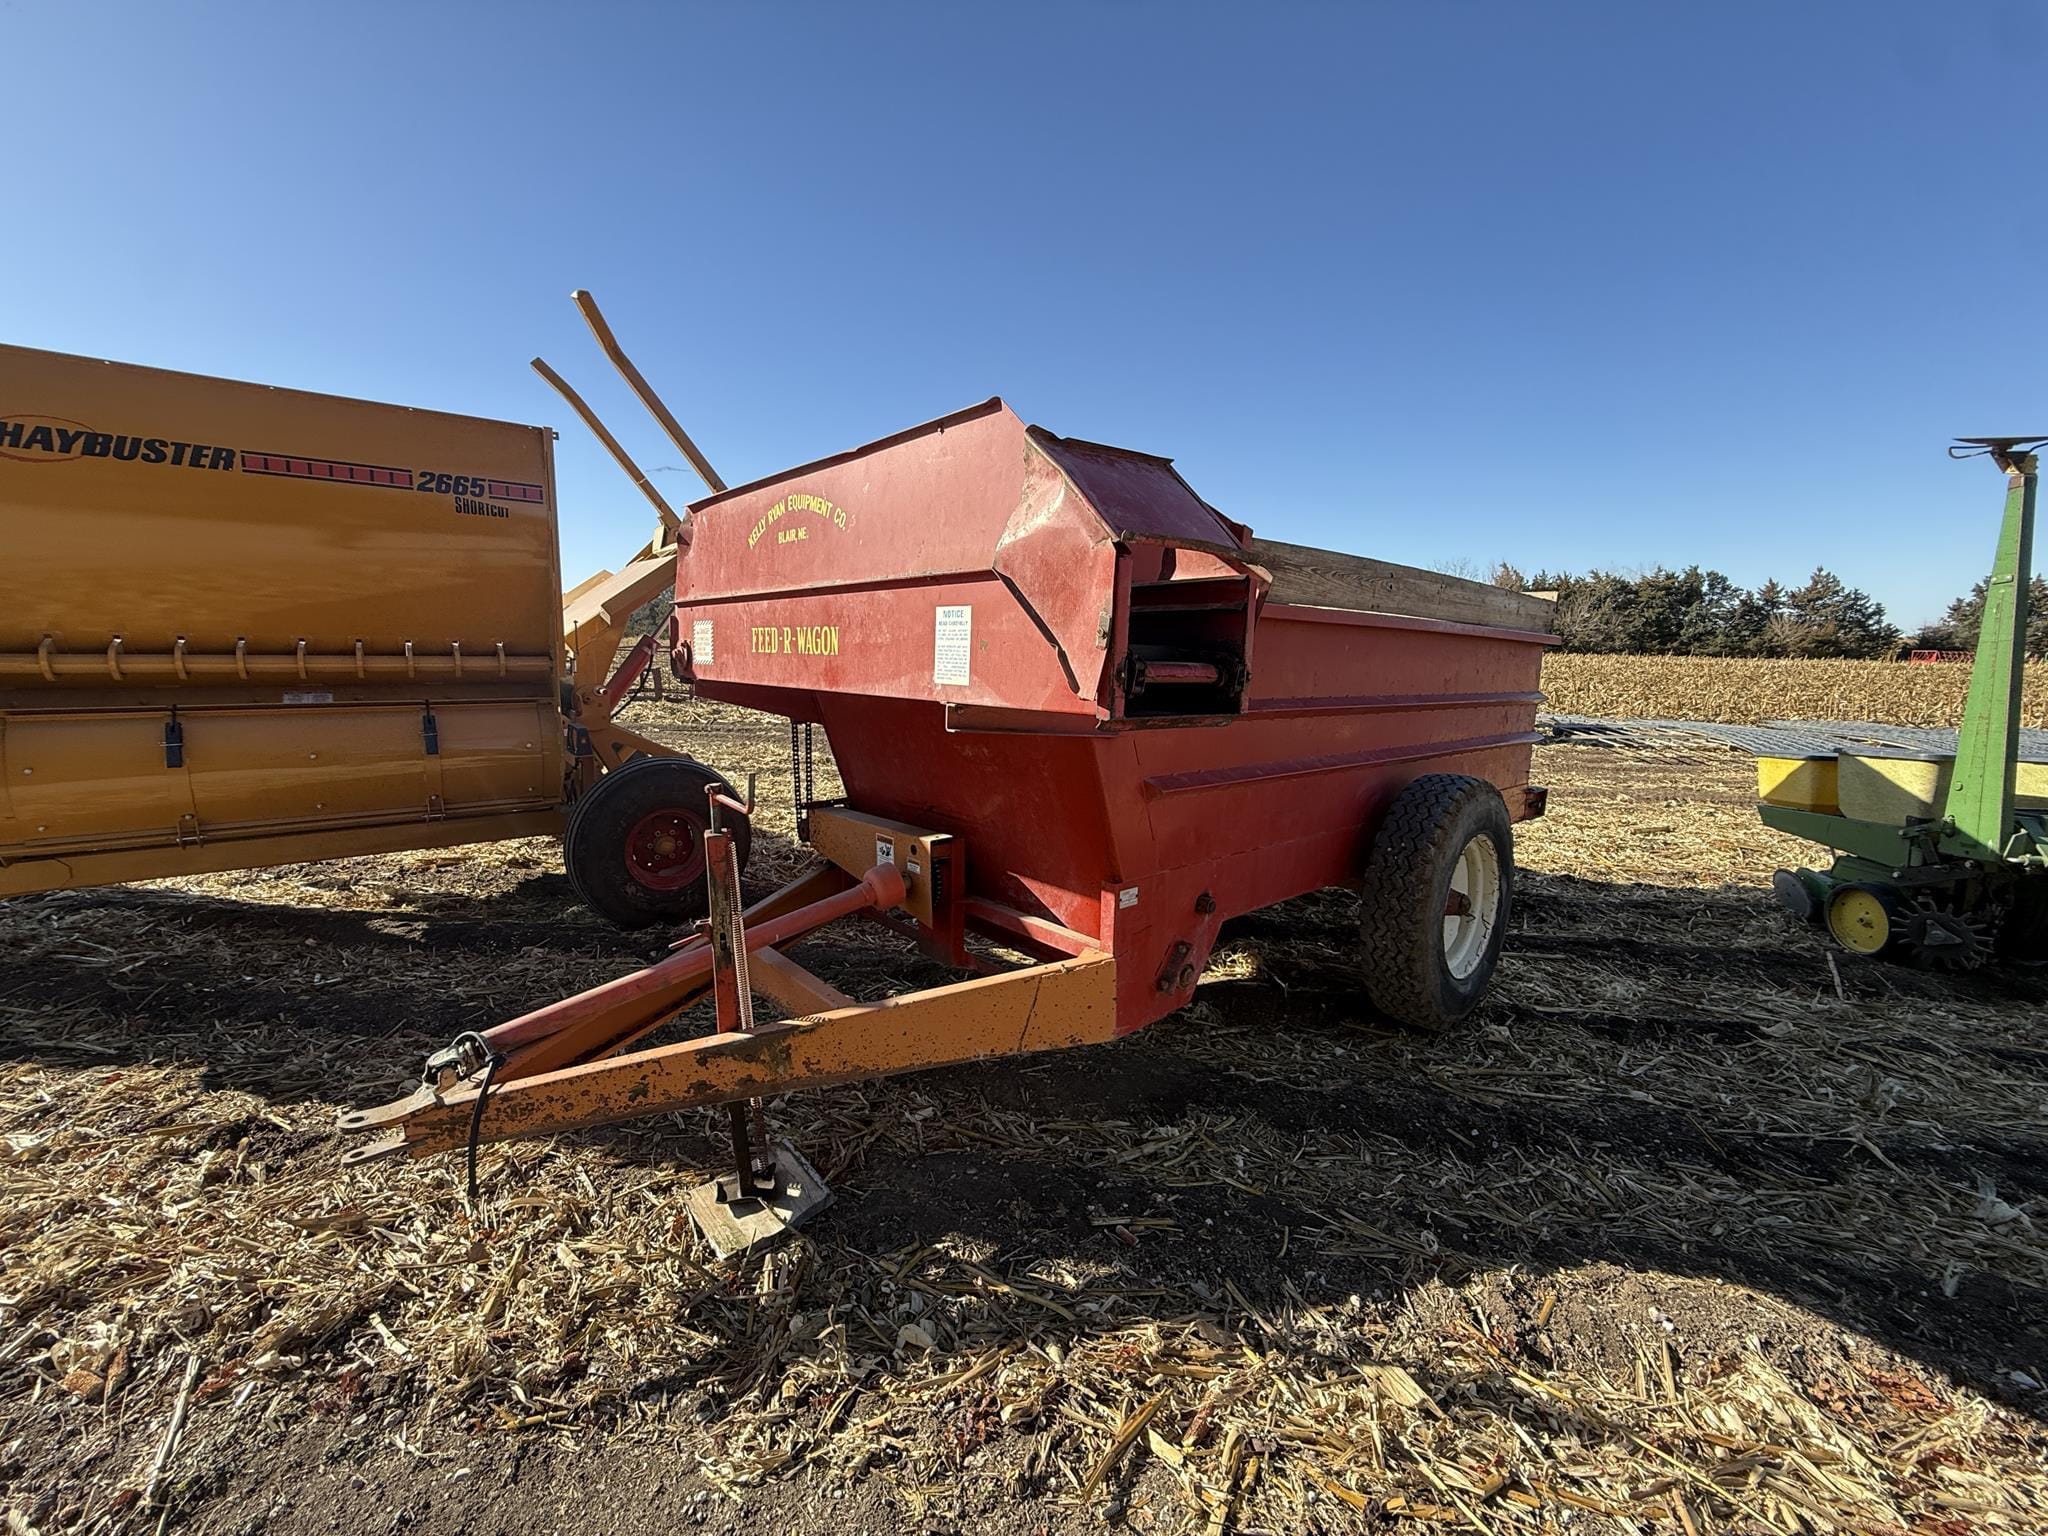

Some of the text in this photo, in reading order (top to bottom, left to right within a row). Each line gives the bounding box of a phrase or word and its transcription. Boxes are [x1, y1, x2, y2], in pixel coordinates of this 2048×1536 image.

[0, 422, 486, 497] HAYBUSTER 2665
[455, 496, 509, 518] SHORTCUT
[747, 494, 847, 549] KELLY RYAN EQUIPMENT CO.
[942, 609, 964, 618] NOTICE
